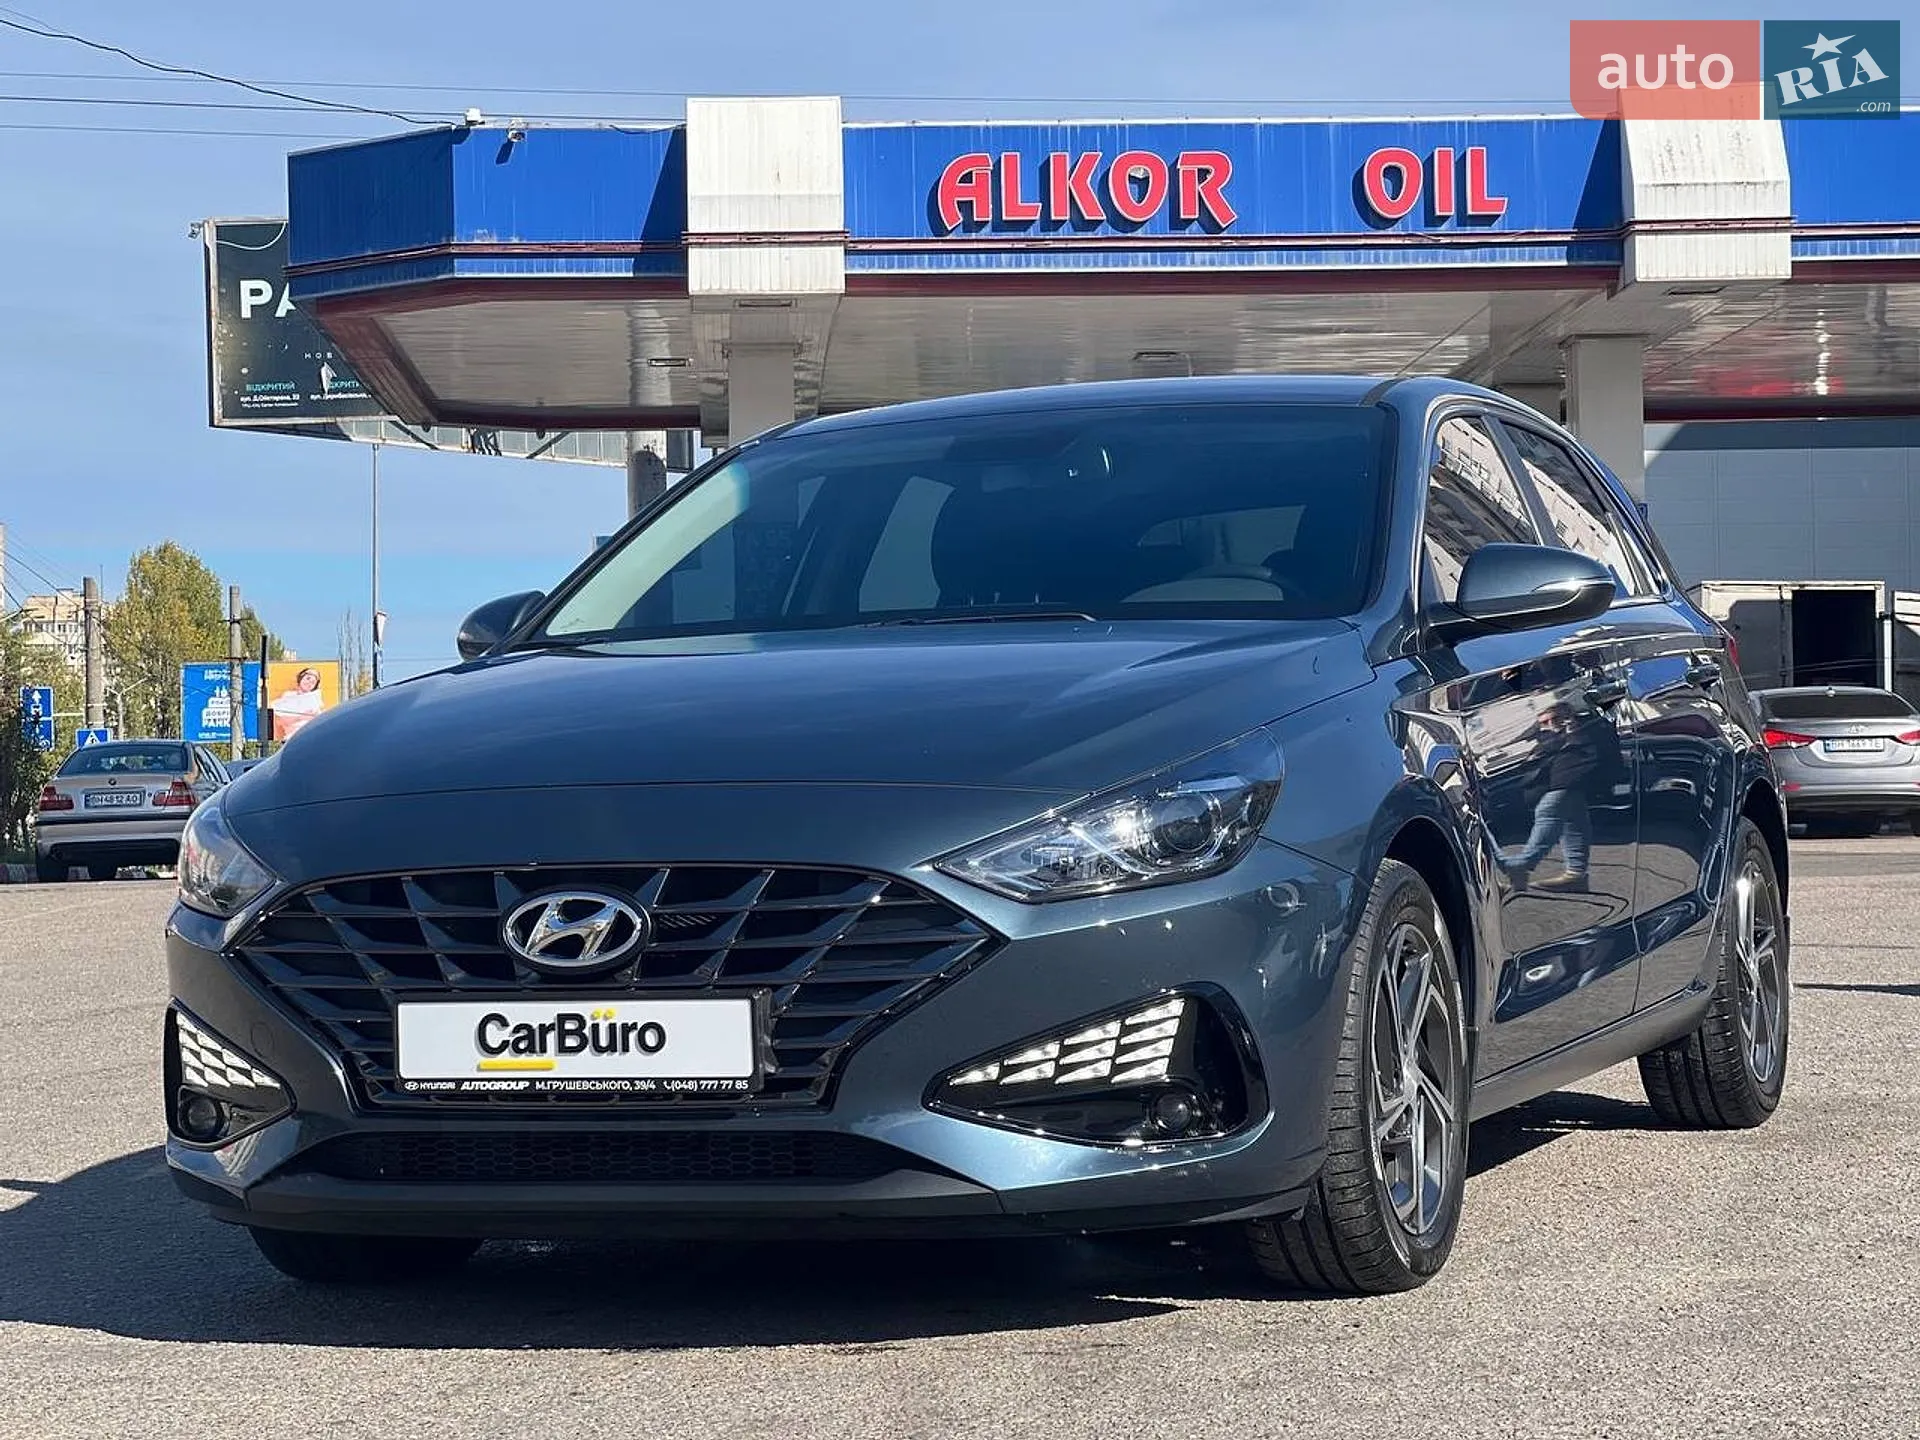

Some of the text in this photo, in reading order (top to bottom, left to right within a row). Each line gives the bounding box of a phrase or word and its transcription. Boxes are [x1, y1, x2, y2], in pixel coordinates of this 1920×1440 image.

[937, 146, 1508, 230] ALKOR OIL
[477, 1009, 667, 1056] CarBüro
[460, 1081, 530, 1091] AUTOGROUP
[634, 1080, 656, 1090] 39/4
[699, 1080, 718, 1089] 777
[719, 1080, 733, 1089] 77
[734, 1080, 749, 1089] 85
